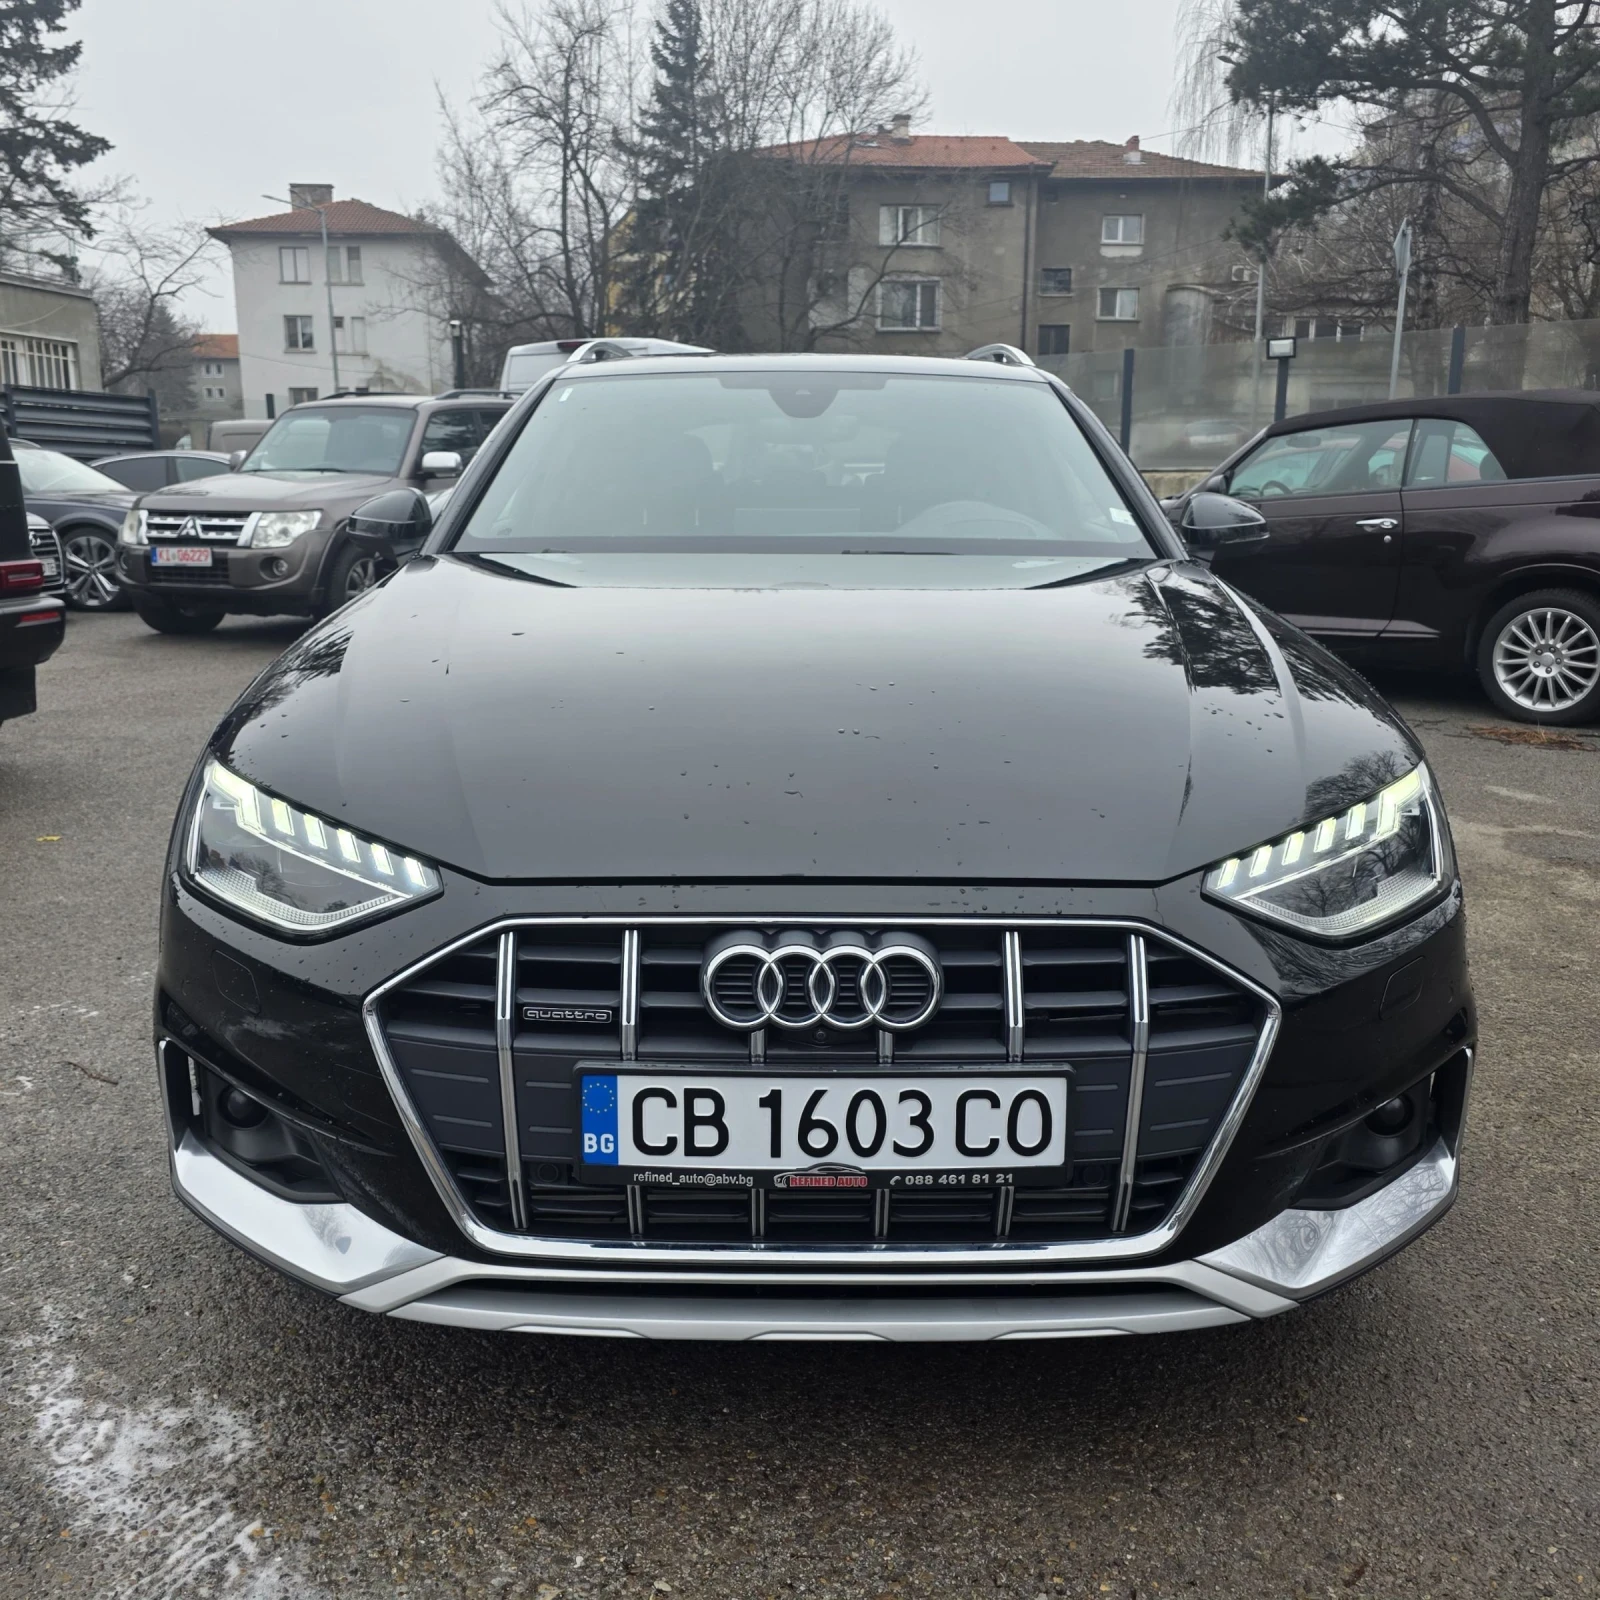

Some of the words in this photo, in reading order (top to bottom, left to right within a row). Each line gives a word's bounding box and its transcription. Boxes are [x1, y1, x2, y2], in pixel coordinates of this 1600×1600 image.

[527, 1010, 607, 1020] quattro
[632, 1087, 730, 1157] CB
[758, 1088, 934, 1158] 1603
[583, 1132, 615, 1155] BG
[633, 1171, 754, 1187] refined_auto@abv.bg
[789, 1175, 836, 1187] REFINED
[836, 1175, 868, 1187] AUTO
[905, 1175, 934, 1185] 088
[938, 1174, 966, 1184] 461
[971, 1173, 990, 1184] 81
[995, 1173, 1014, 1183] 21
